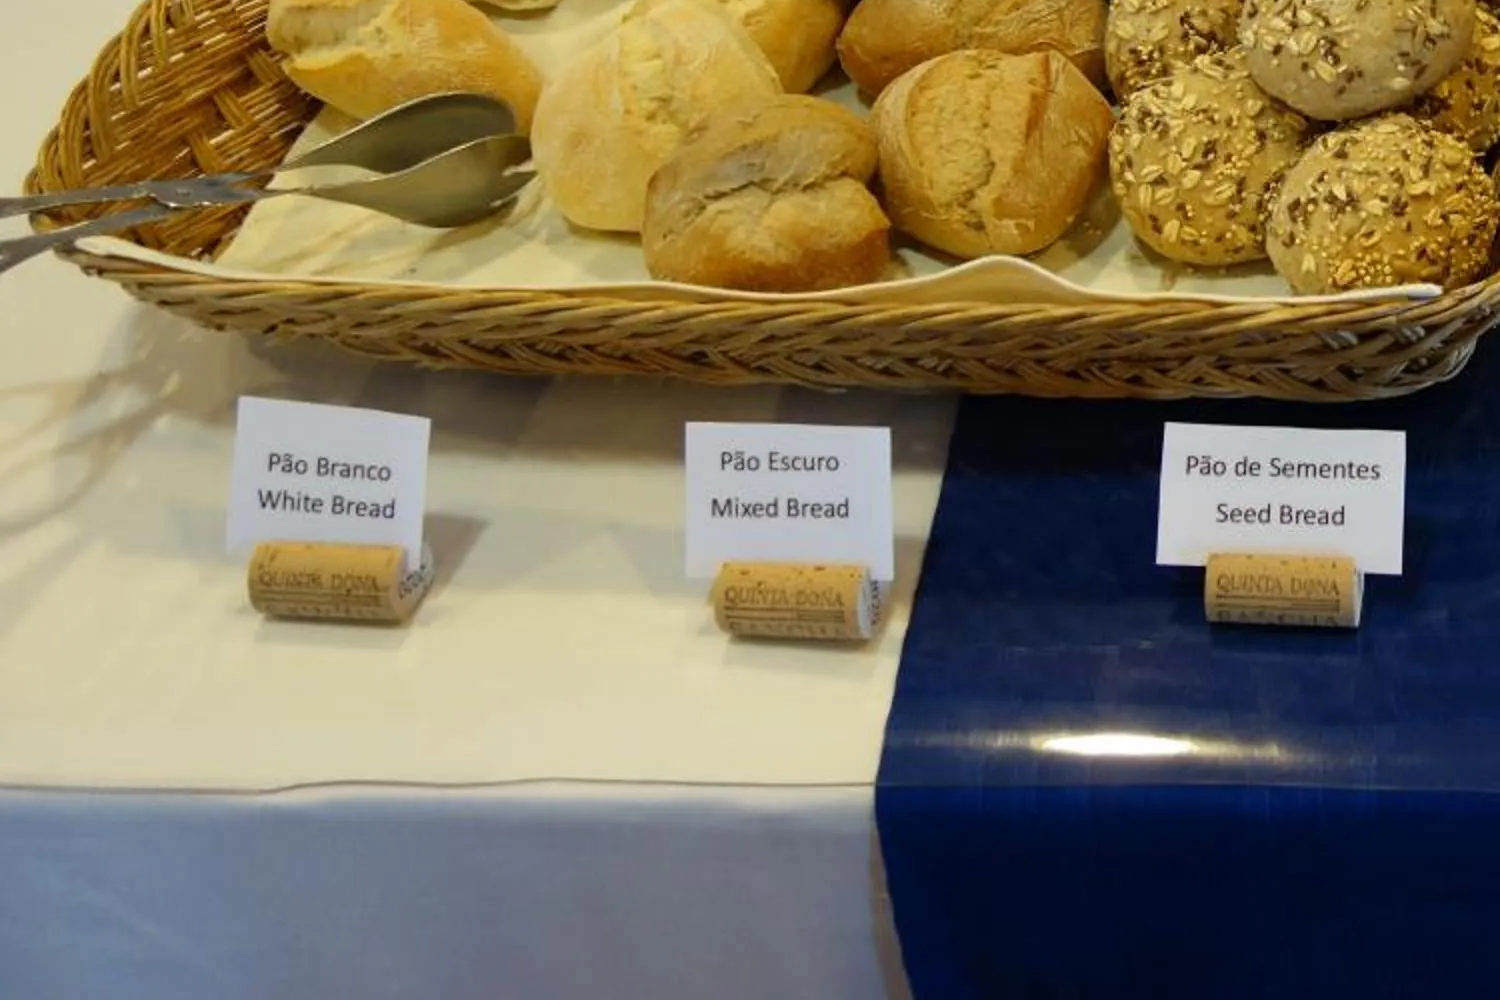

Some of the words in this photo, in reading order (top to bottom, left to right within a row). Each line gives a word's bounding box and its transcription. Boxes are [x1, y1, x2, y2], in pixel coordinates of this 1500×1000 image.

[268, 452, 308, 475] Pão
[316, 457, 392, 481] Branco
[720, 451, 760, 472] Pão
[768, 451, 840, 472] Escuro
[1185, 455, 1227, 477] Pão
[1234, 456, 1261, 477] de
[1269, 457, 1381, 481] Sementes
[257, 489, 324, 514] White
[331, 495, 396, 519] Bread
[710, 497, 779, 519] Mixed
[786, 497, 850, 519] Bread
[1216, 503, 1272, 524] Seed
[1279, 504, 1346, 526] Bread
[1216, 573, 1283, 594] QUINTA
[724, 585, 789, 606] QUINTA
